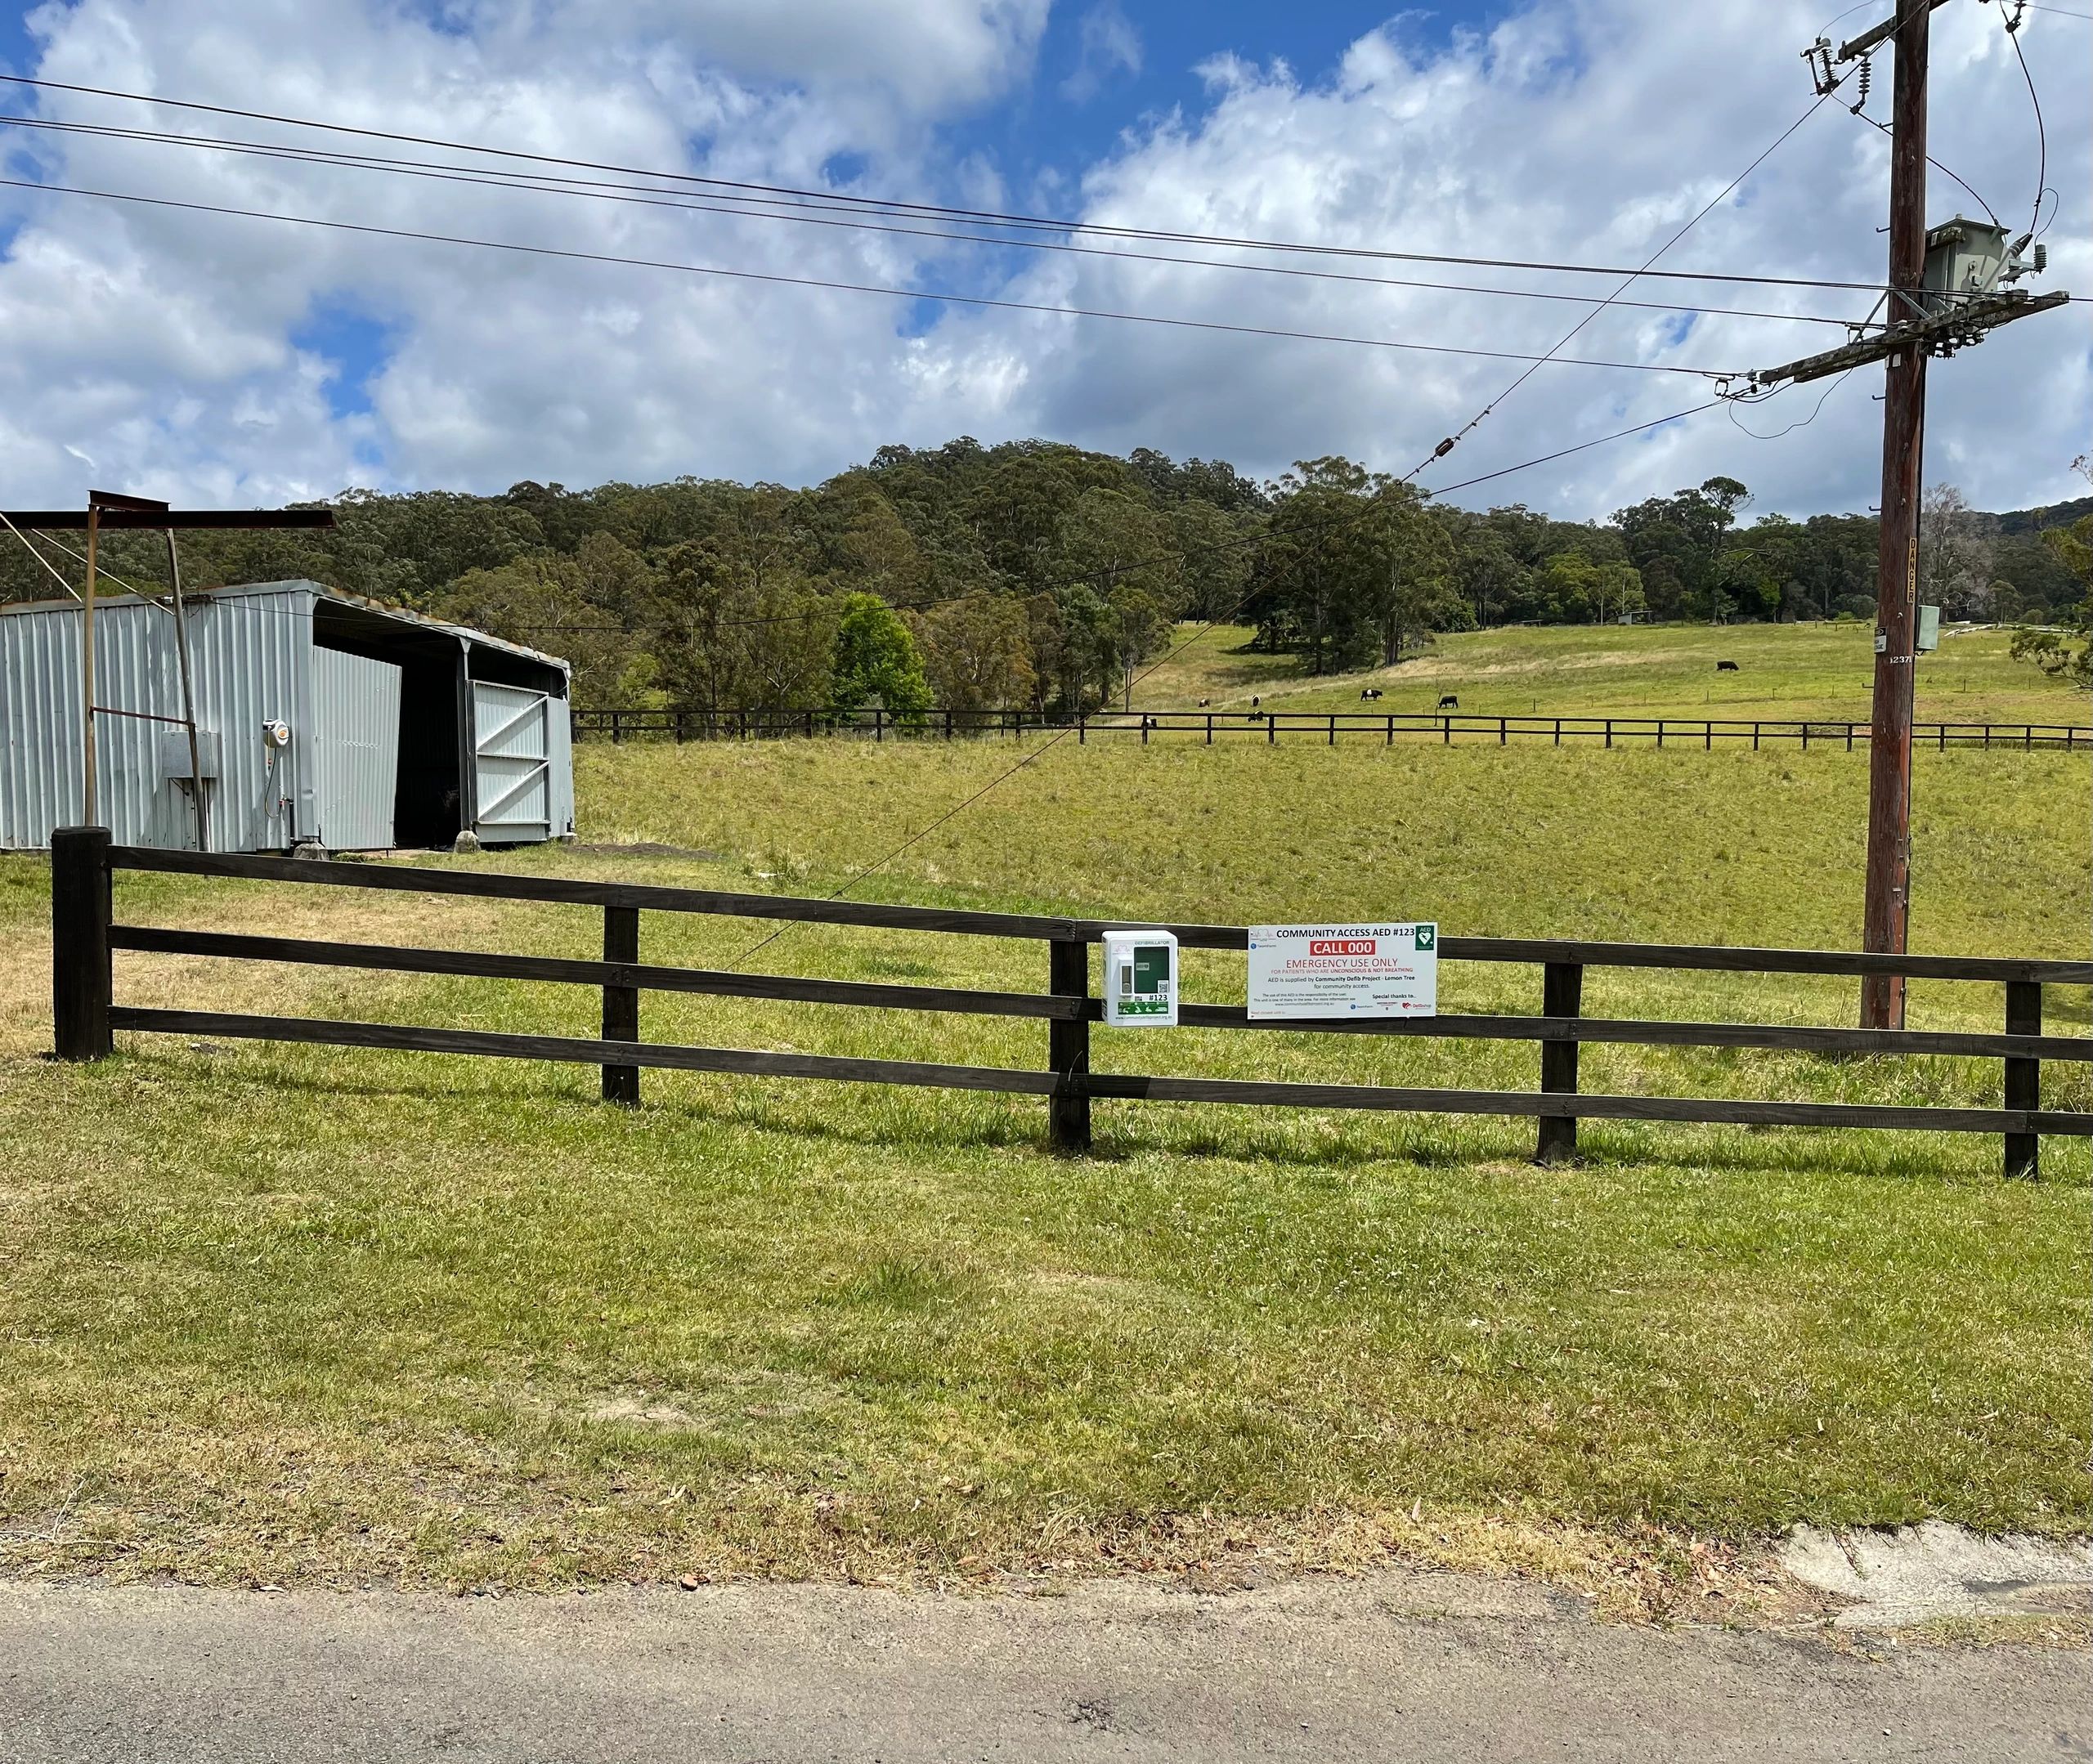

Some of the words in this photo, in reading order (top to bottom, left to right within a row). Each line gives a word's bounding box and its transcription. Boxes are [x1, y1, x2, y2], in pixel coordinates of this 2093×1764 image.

[1276, 929, 1336, 938] COMMUNITY
[1337, 929, 1370, 937] ACCESS
[1372, 928, 1391, 936] AED
[1393, 928, 1415, 936] #123
[1313, 942, 1345, 954] CALL
[1347, 942, 1372, 953] 000
[1286, 959, 1347, 969] EMERGENCY
[1351, 958, 1369, 967] USE
[1372, 958, 1398, 967] ONLY
